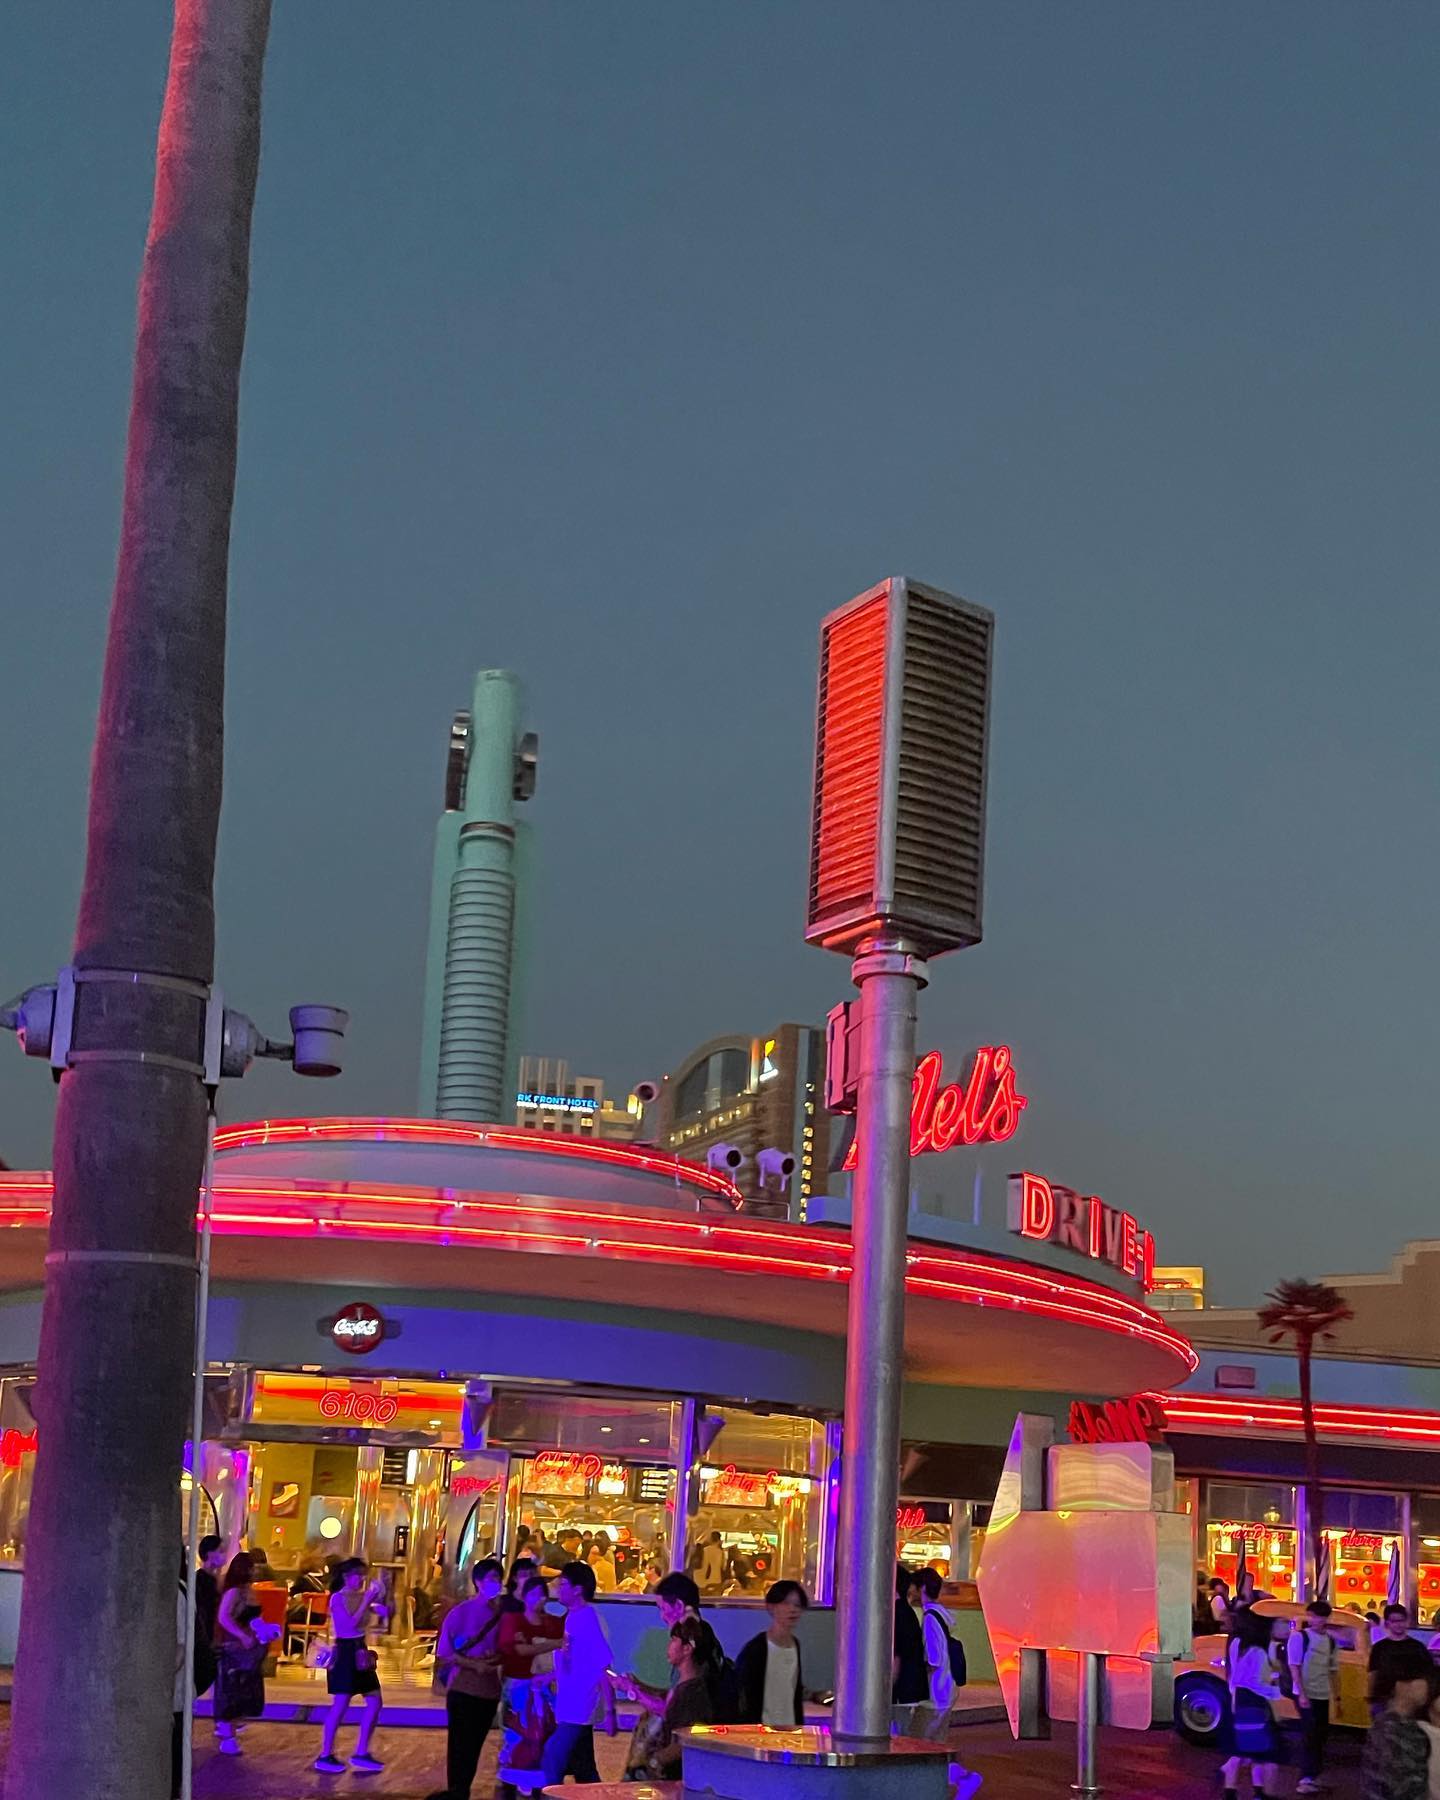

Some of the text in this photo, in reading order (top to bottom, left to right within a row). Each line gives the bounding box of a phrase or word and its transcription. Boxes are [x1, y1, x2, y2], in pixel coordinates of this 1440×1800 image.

[533, 1095, 567, 1106] FRONT
[567, 1098, 599, 1109] HOTEL
[319, 1391, 398, 1424] 6100
